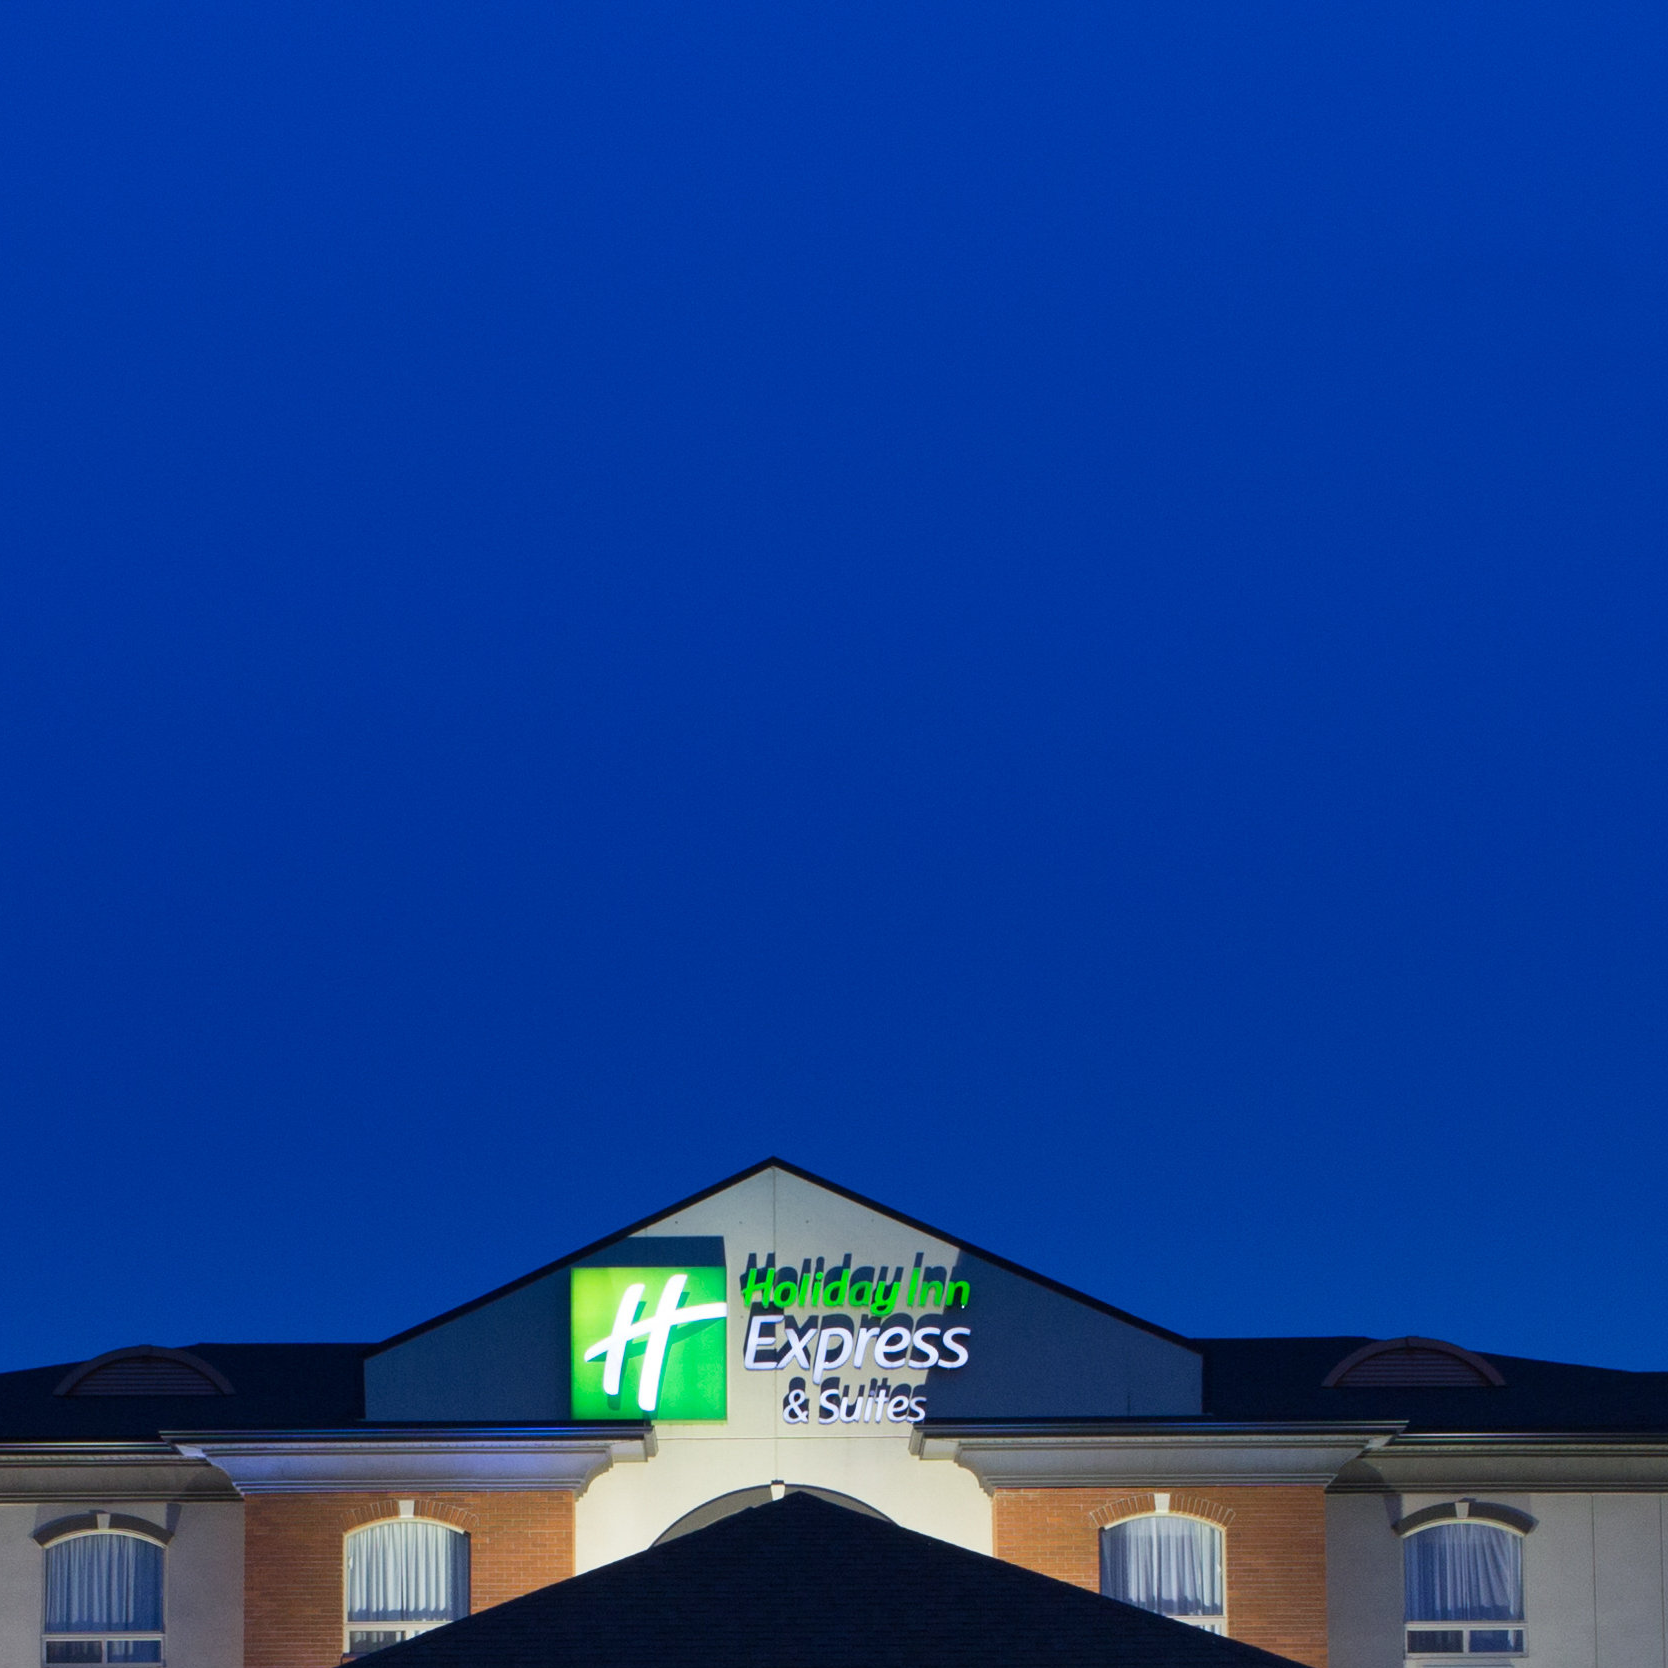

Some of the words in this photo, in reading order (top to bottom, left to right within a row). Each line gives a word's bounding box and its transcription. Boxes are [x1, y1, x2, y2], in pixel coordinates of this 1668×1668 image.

[742, 1267, 901, 1316] Holiday
[906, 1267, 971, 1307] Inn
[744, 1314, 972, 1385] Express
[783, 1388, 810, 1424] &
[818, 1388, 928, 1424] Suites
